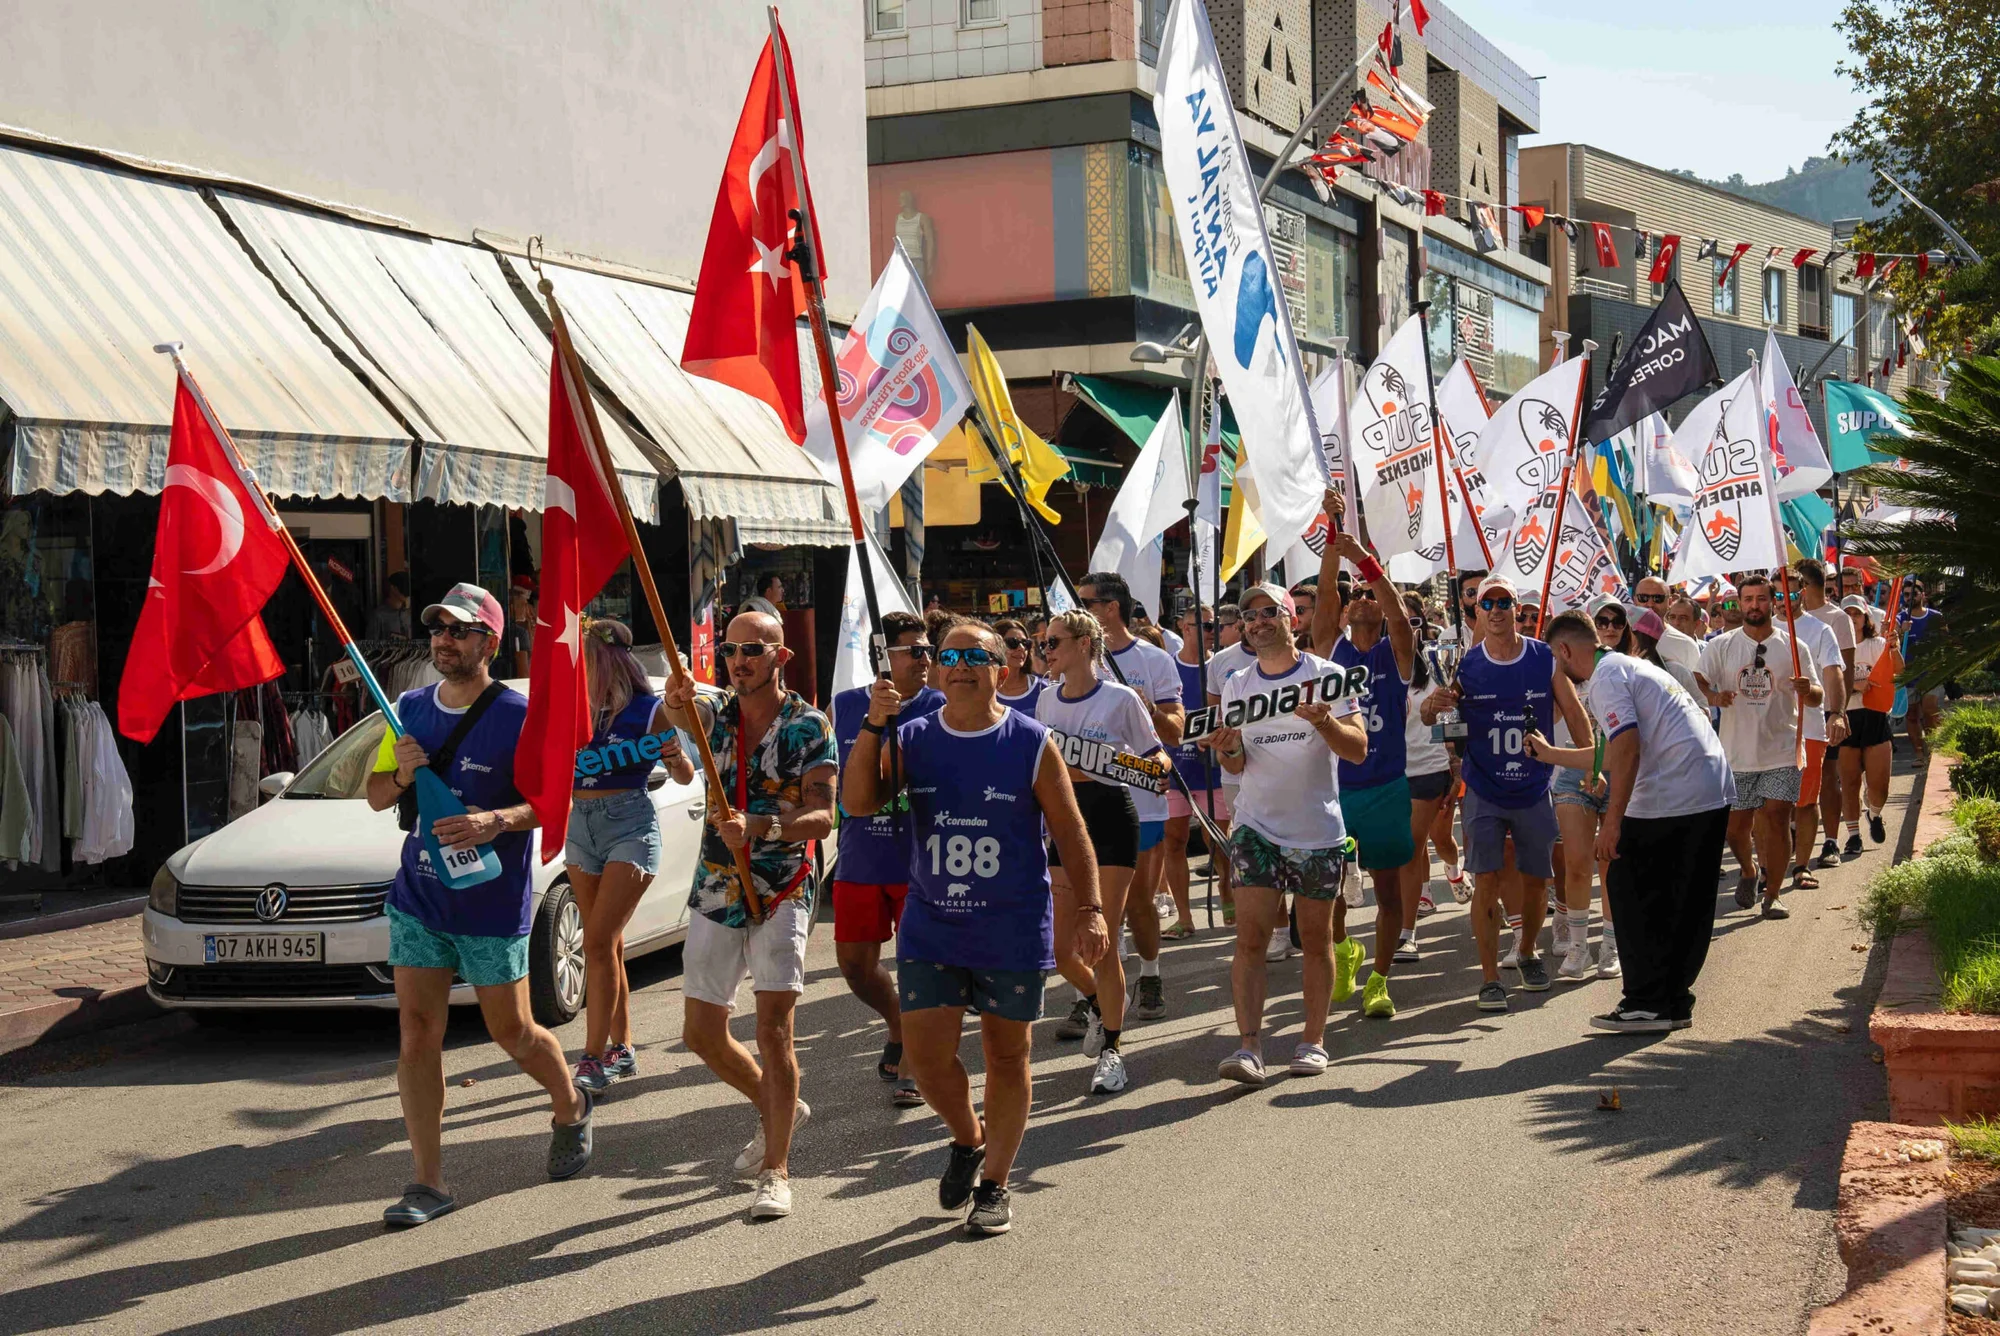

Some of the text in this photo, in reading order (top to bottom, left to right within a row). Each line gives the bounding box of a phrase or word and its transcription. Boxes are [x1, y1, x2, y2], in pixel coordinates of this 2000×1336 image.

[1082, 728, 1107, 740] TEAM
[574, 727, 677, 778] emer
[467, 761, 493, 773] kemer
[1117, 751, 1162, 776] KEMER
[992, 791, 1017, 802] kemer
[946, 816, 988, 827] corendon
[446, 848, 478, 869] 160
[926, 834, 1001, 878] 188
[216, 938, 238, 958] 07
[245, 937, 277, 958] AKH
[283, 937, 316, 957] 945
